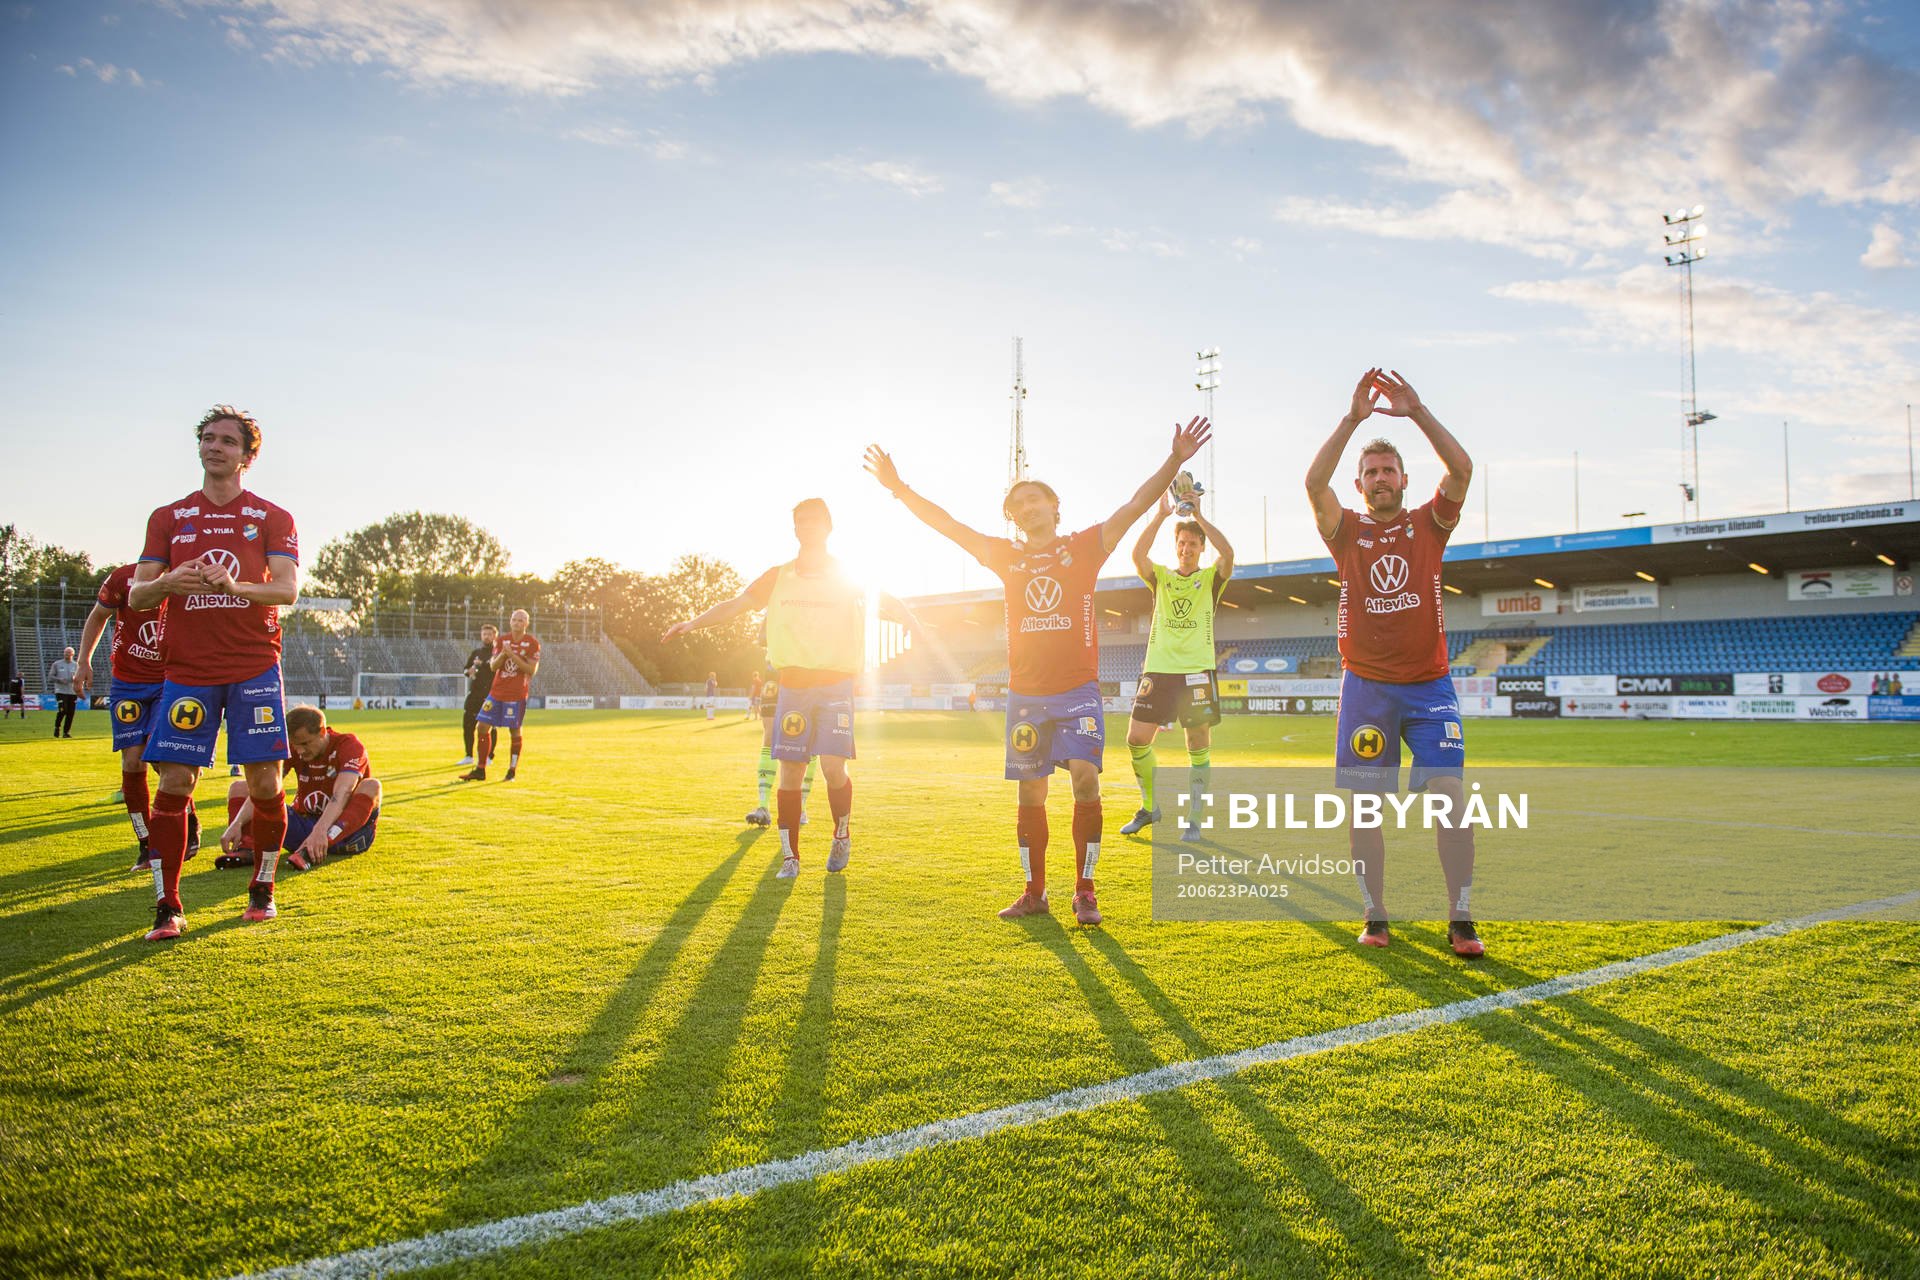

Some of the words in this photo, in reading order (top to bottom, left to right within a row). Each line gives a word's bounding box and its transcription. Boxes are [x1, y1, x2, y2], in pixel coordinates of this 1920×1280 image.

[1684, 522, 1726, 536] Trelleborgs
[1728, 519, 1765, 532] Allehanda
[185, 593, 250, 611] Atteviks
[1338, 580, 1349, 639] EMILSHUS
[1365, 593, 1420, 613] Atteviks
[1497, 591, 1542, 614] umia
[1020, 614, 1072, 633] Atteviks
[1083, 593, 1092, 648] EMILSHUS
[128, 643, 162, 661] Attev
[1618, 677, 1673, 692] CMM
[1248, 698, 1288, 711] UNIBET
[248, 726, 281, 734] BALCO
[1076, 729, 1102, 740] BALCO
